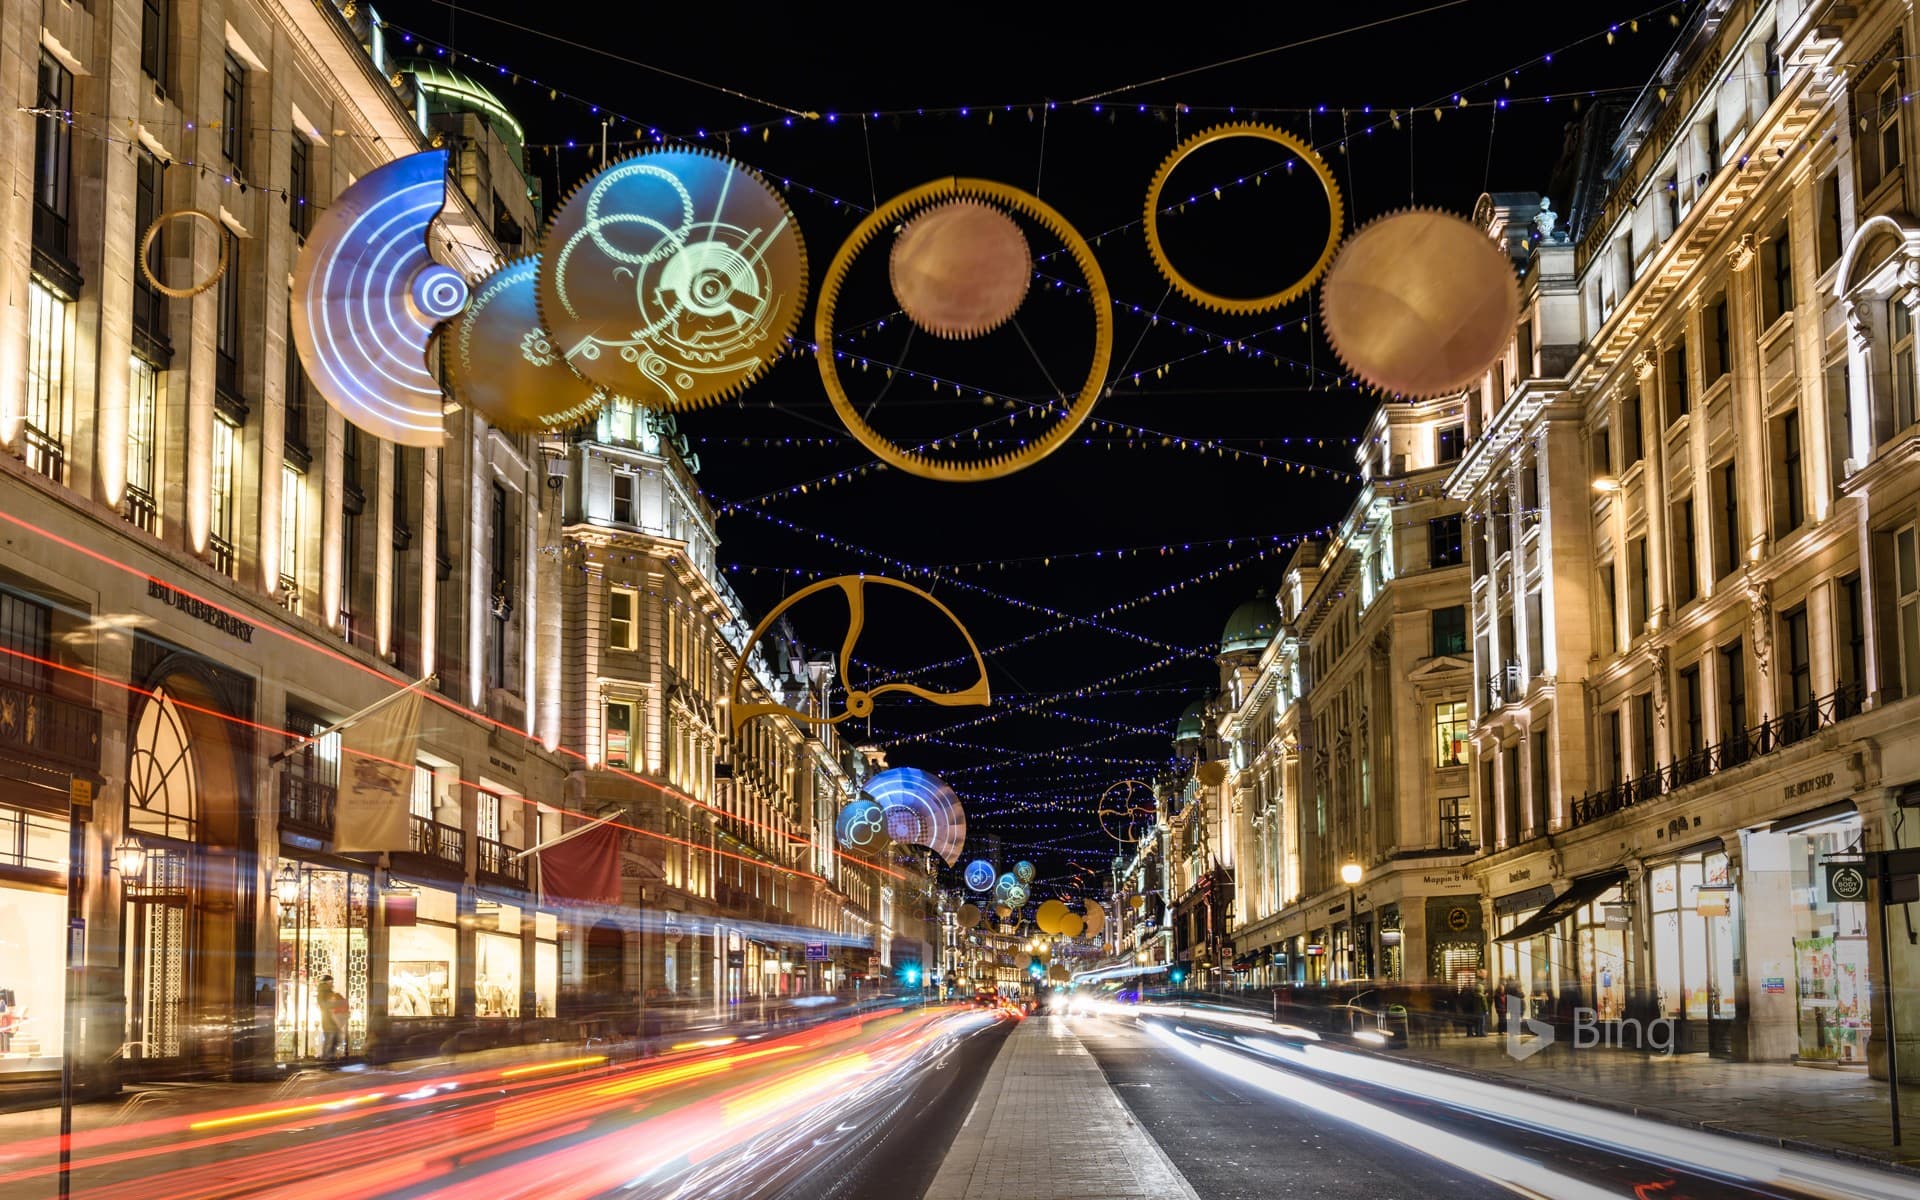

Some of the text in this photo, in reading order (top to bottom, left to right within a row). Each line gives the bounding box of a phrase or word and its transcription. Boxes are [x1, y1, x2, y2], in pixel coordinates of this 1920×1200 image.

[148, 577, 255, 644] BURBERRY
[1784, 785, 1796, 800] THE
[1797, 778, 1815, 796] BODY
[1424, 876, 1452, 885] Mappin
